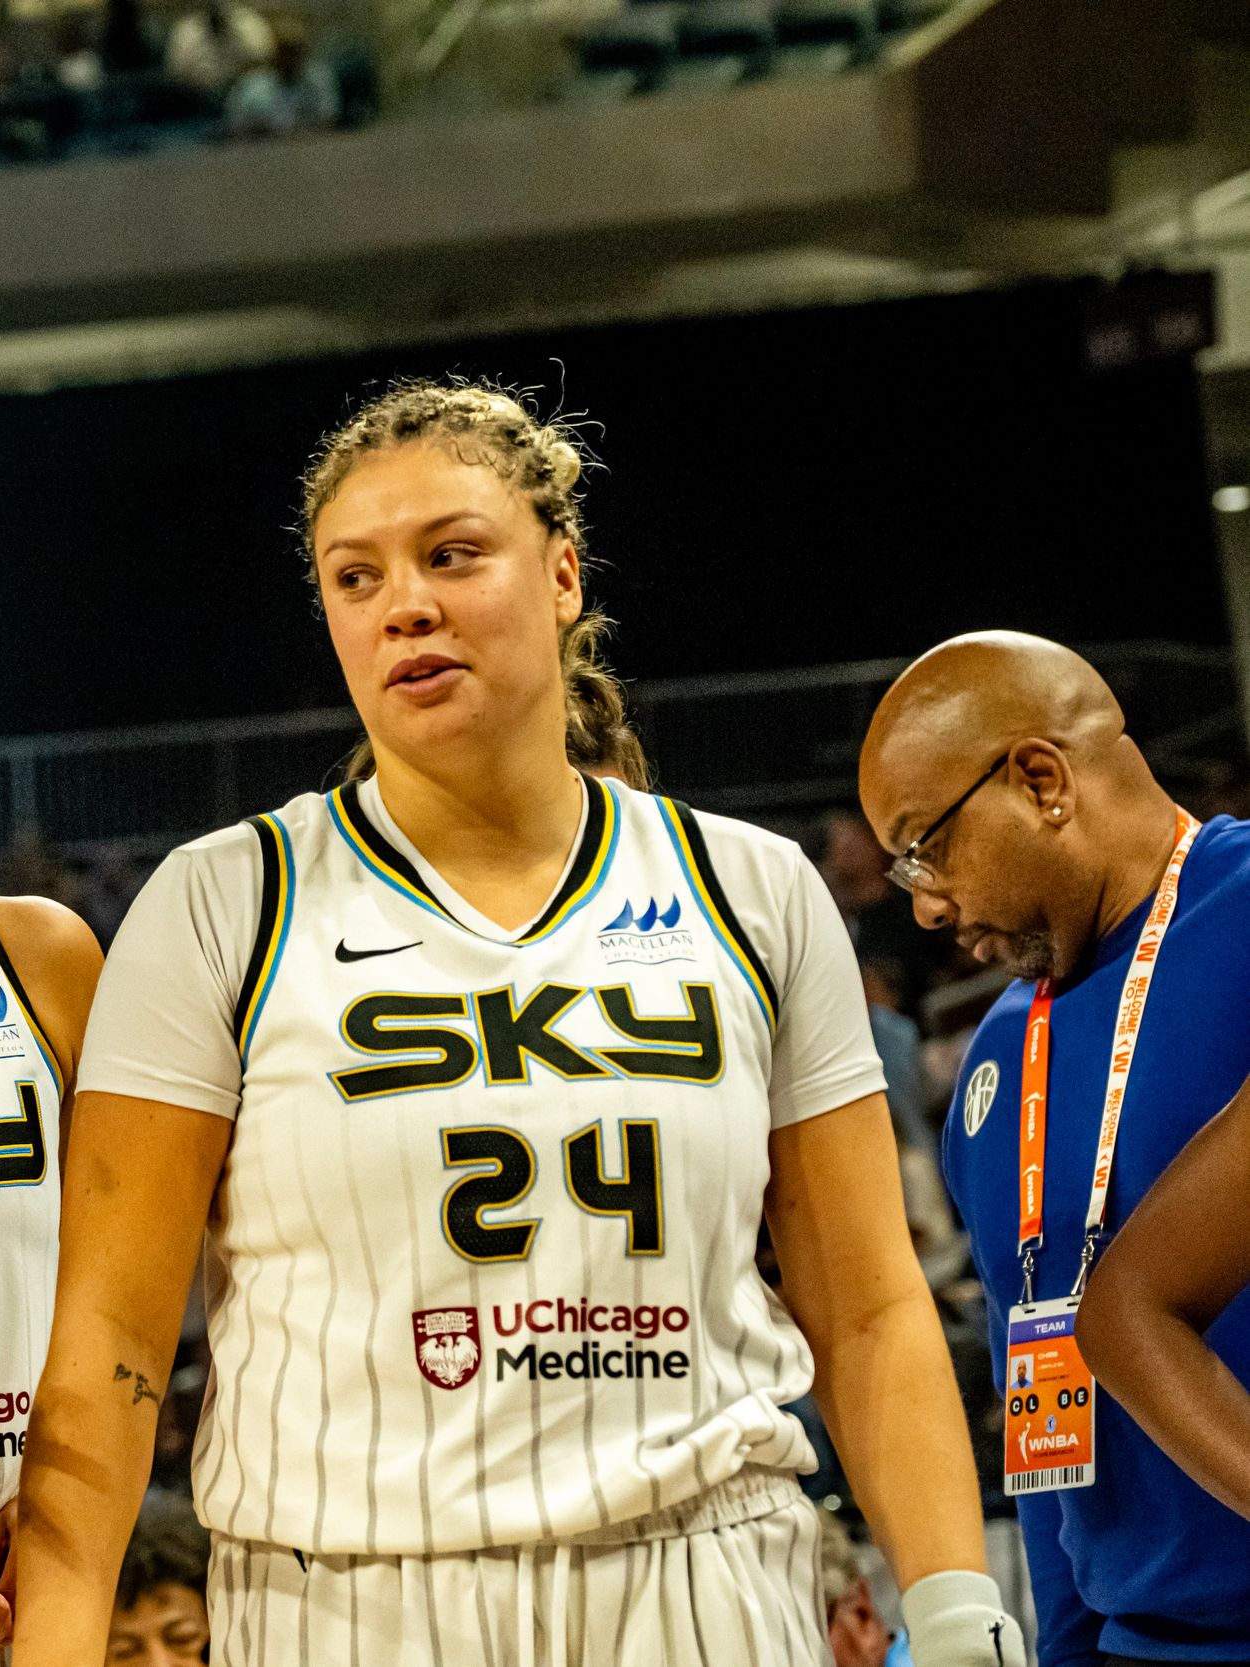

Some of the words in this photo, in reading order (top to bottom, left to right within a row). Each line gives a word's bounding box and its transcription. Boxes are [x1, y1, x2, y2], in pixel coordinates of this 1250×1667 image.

[599, 934, 693, 950] MAGELLAN
[1125, 977, 1138, 999] TO
[1126, 976, 1149, 1035] WELCOME
[1118, 1003, 1131, 1036] THE
[326, 980, 725, 1104] SKY
[1027, 1101, 1036, 1141] WNBA
[1106, 1088, 1123, 1147] WELCOME
[439, 1118, 665, 1264] 24
[1027, 1172, 1035, 1215] WNBA
[493, 1298, 690, 1338] UChicago
[1035, 1321, 1066, 1334] TEAM
[497, 1342, 689, 1382] Medicine
[1012, 1400, 1021, 1412] C
[1030, 1398, 1036, 1410] L
[1078, 1391, 1085, 1403] E
[1028, 1433, 1079, 1452] WNBA
